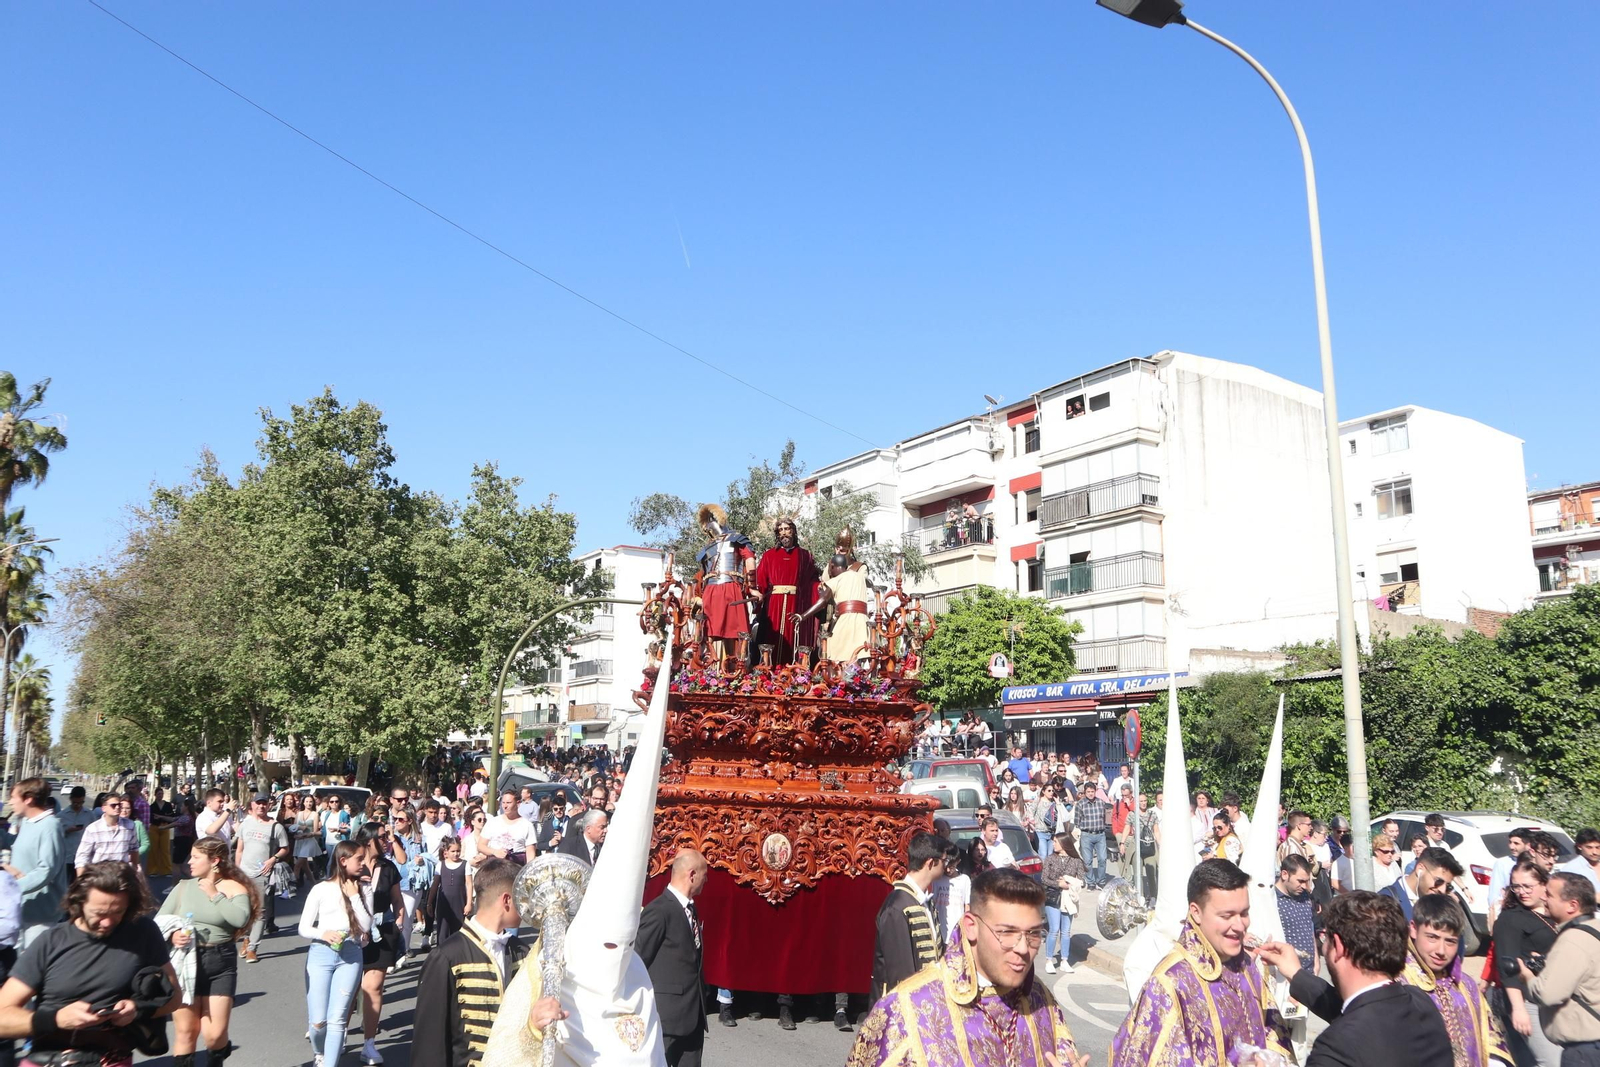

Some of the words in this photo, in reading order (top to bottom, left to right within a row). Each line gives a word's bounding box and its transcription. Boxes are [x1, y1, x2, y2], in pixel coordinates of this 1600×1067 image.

[1008, 688, 1037, 700] KIOSCO
[1046, 686, 1063, 697] BAR
[1070, 683, 1097, 695] NTRA.
[1099, 680, 1120, 693] SRA.
[1123, 678, 1143, 691] DEL
[1032, 719, 1057, 728] KIOSCO
[1062, 718, 1077, 727] BAR
